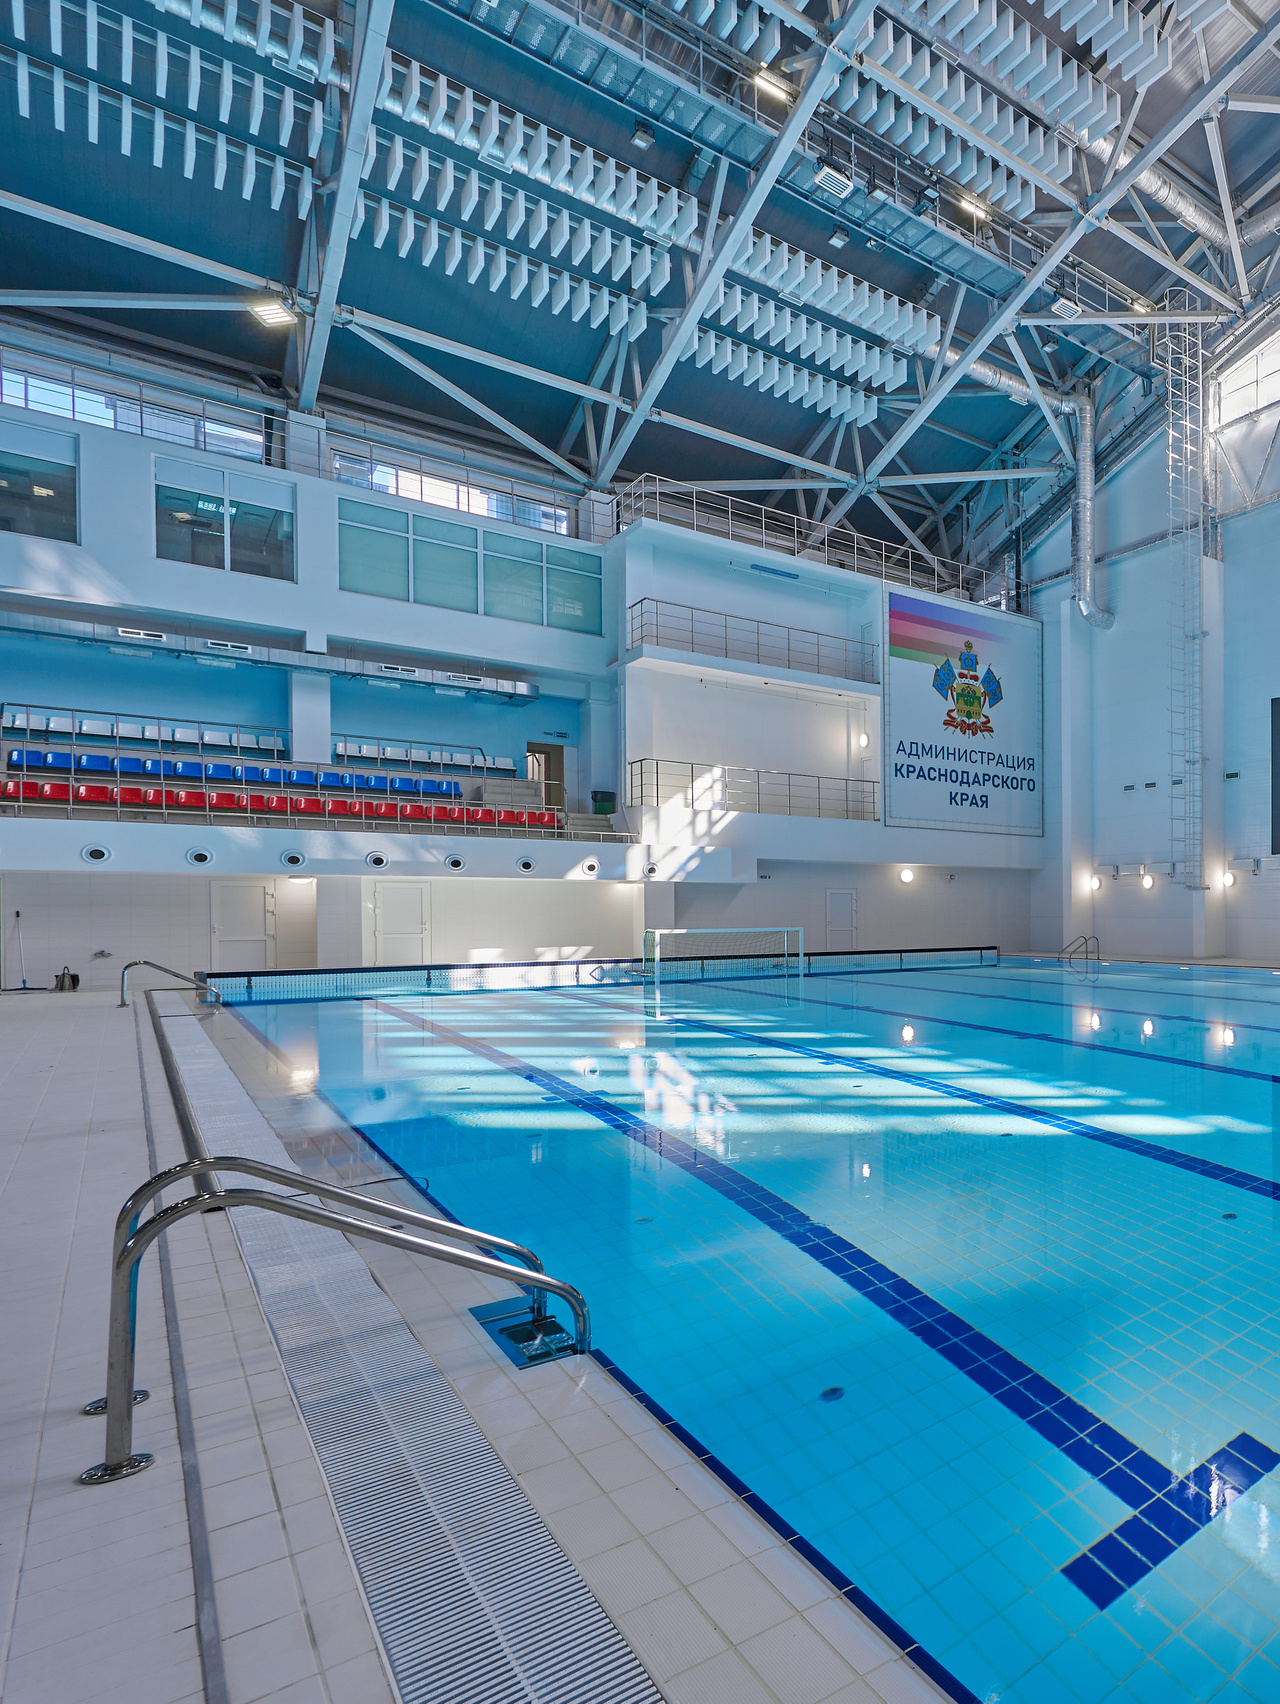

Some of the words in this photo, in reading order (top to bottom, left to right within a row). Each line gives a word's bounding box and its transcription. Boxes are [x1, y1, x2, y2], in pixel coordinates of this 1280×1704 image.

[895, 739, 1036, 772] АДМИНИСТРАЦИЯ
[894, 762, 1037, 792] КРАСНОДАРСКОГО
[949, 791, 989, 809] КРАЯ
